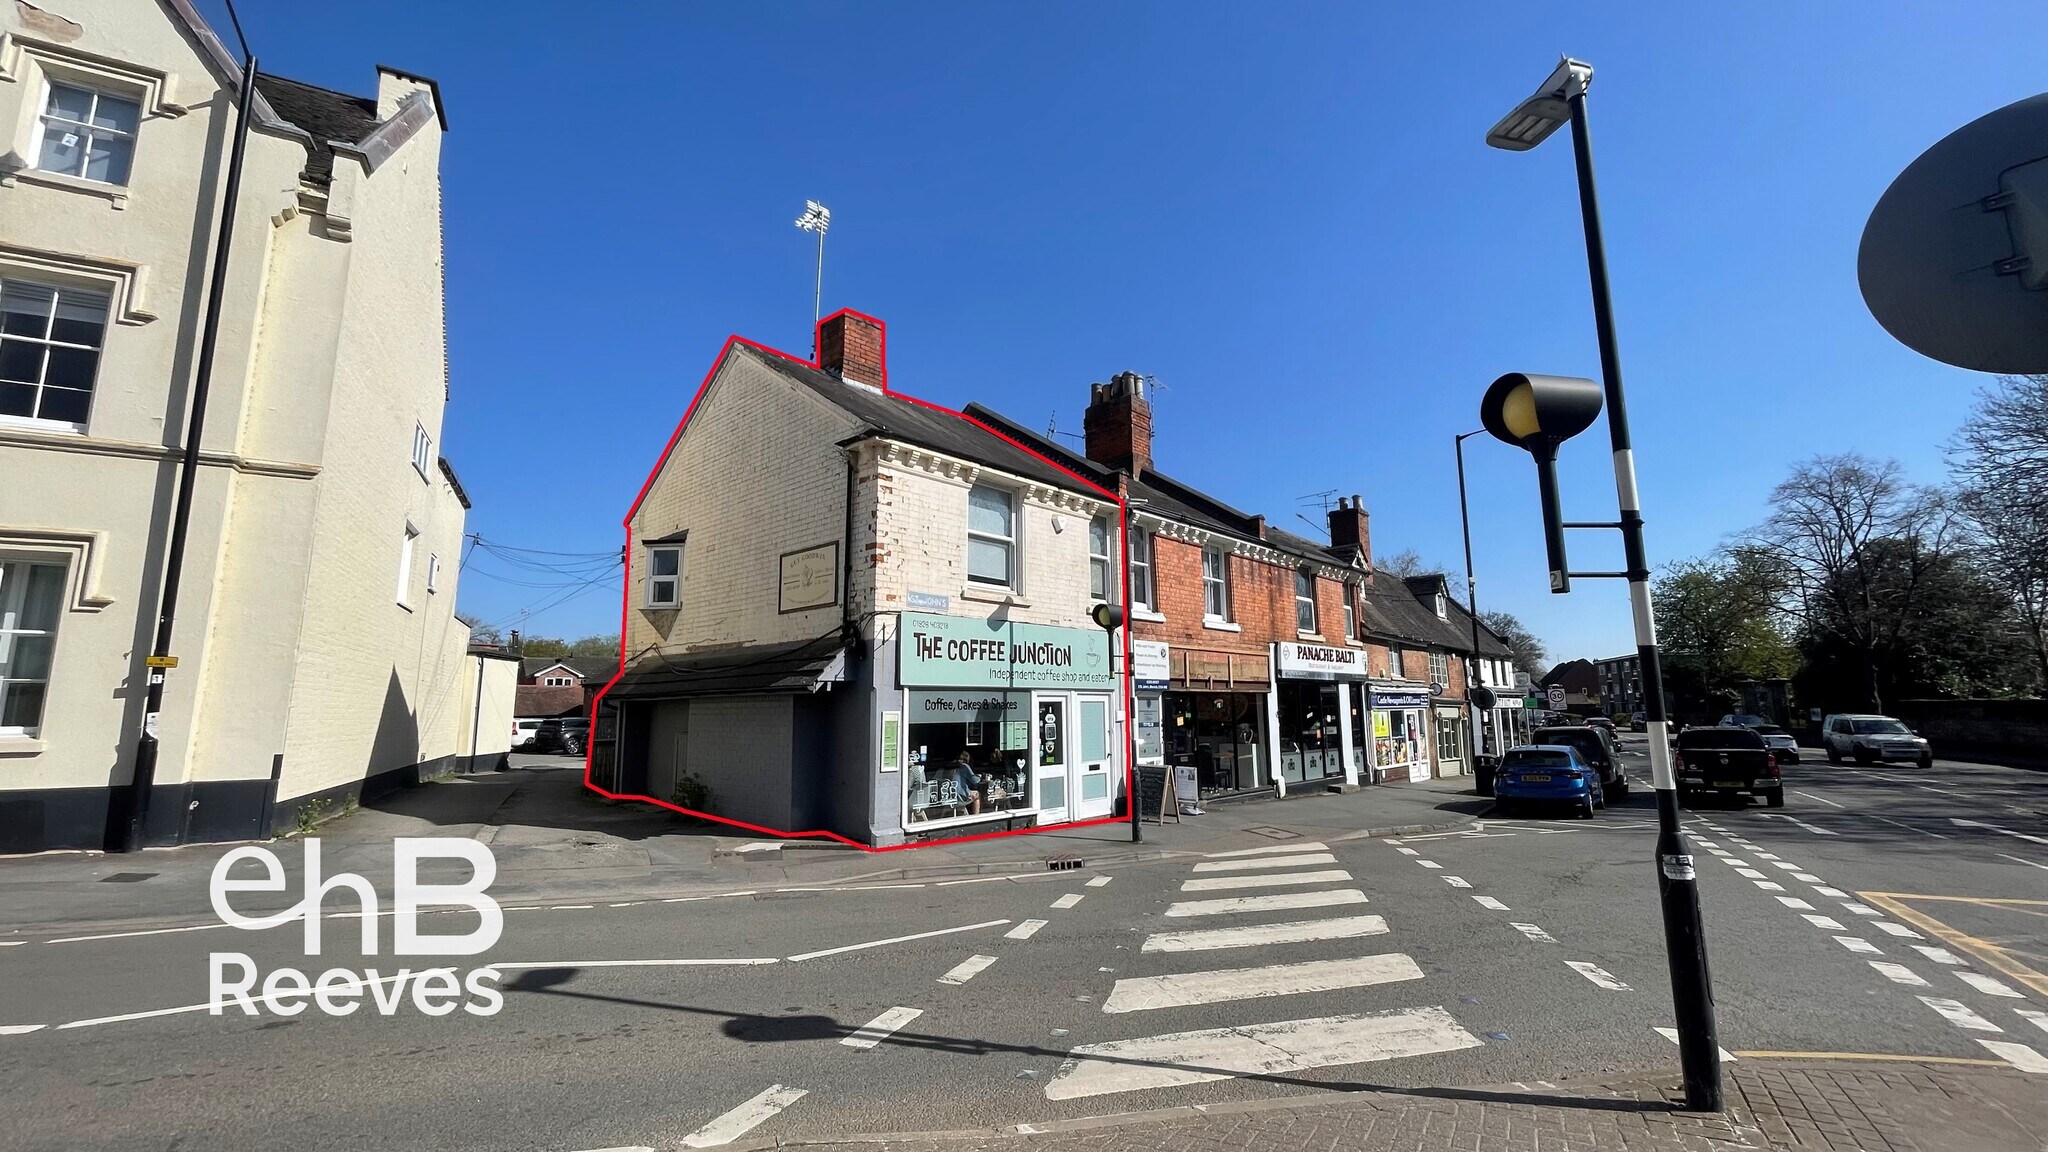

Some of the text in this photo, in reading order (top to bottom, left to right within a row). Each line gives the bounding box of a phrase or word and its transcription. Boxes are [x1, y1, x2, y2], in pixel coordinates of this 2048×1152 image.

[913, 632, 1072, 667] THE COFFEE JUNCTION
[1297, 646, 1355, 664] PANACHE BALTI
[989, 667, 1036, 681] Independent
[1037, 668, 1060, 681] coffee
[1061, 670, 1077, 683] shop
[1078, 671, 1090, 682] and
[925, 697, 1018, 712] Coffee, Cakes & Shakes
